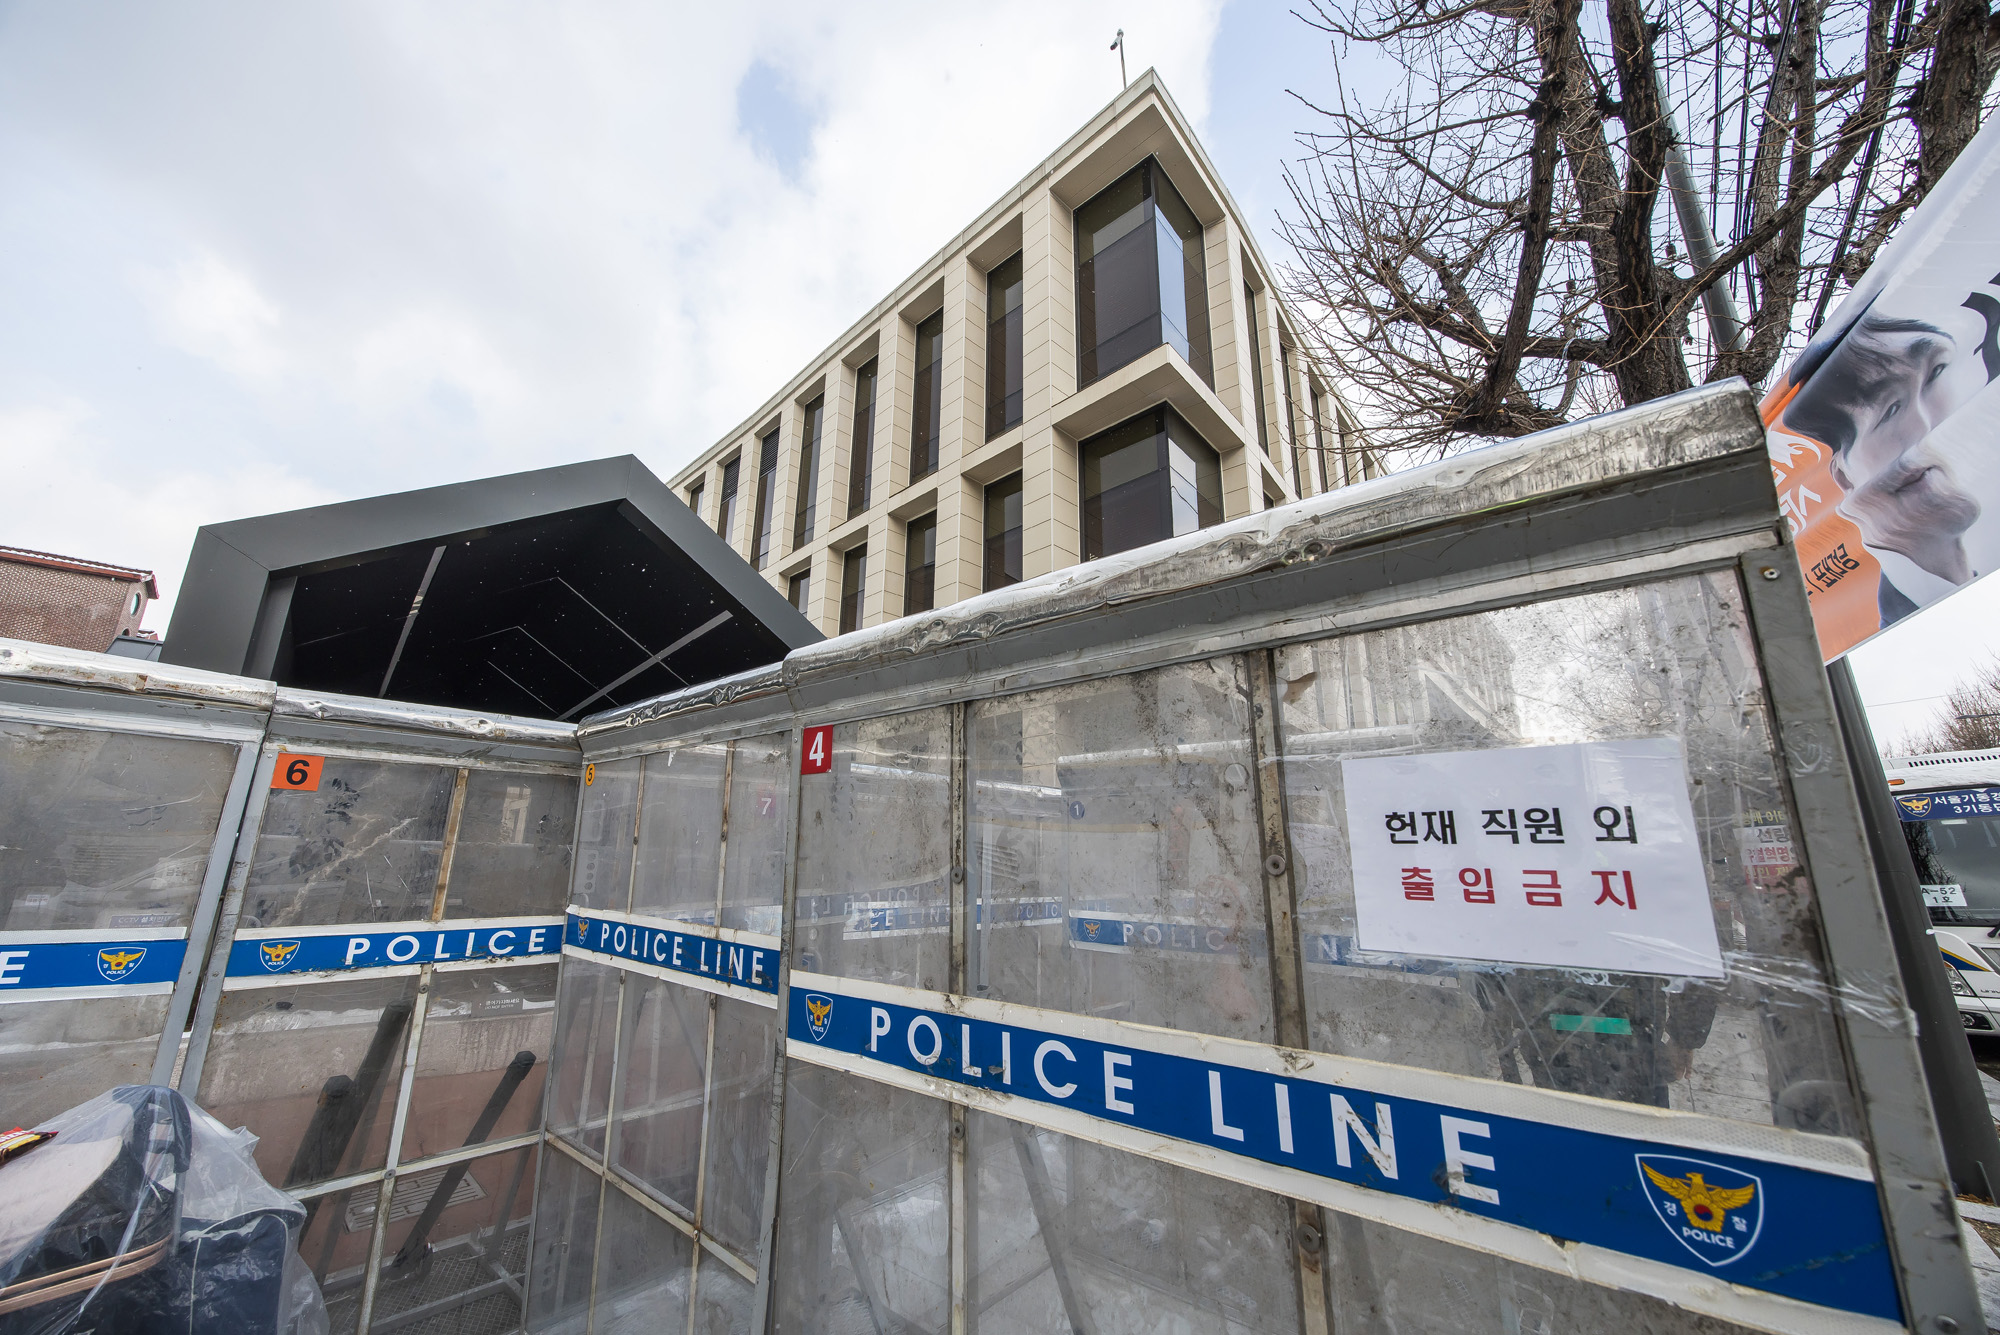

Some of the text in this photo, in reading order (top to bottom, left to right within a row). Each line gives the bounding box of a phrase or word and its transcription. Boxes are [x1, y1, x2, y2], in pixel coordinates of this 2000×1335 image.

[809, 731, 825, 767] 4
[286, 759, 310, 785] 6
[587, 767, 594, 782] 5
[761, 797, 772, 815] 7
[1384, 805, 1639, 845] 헌재 직원 외
[1017, 904, 1062, 918] POLIC
[345, 928, 546, 966] POLICE
[600, 922, 764, 985] POLICE LINE
[870, 1006, 1500, 1206] POLICE LINE
[1663, 1200, 1678, 1217] 경
[1682, 1226, 1736, 1250] POLICE
